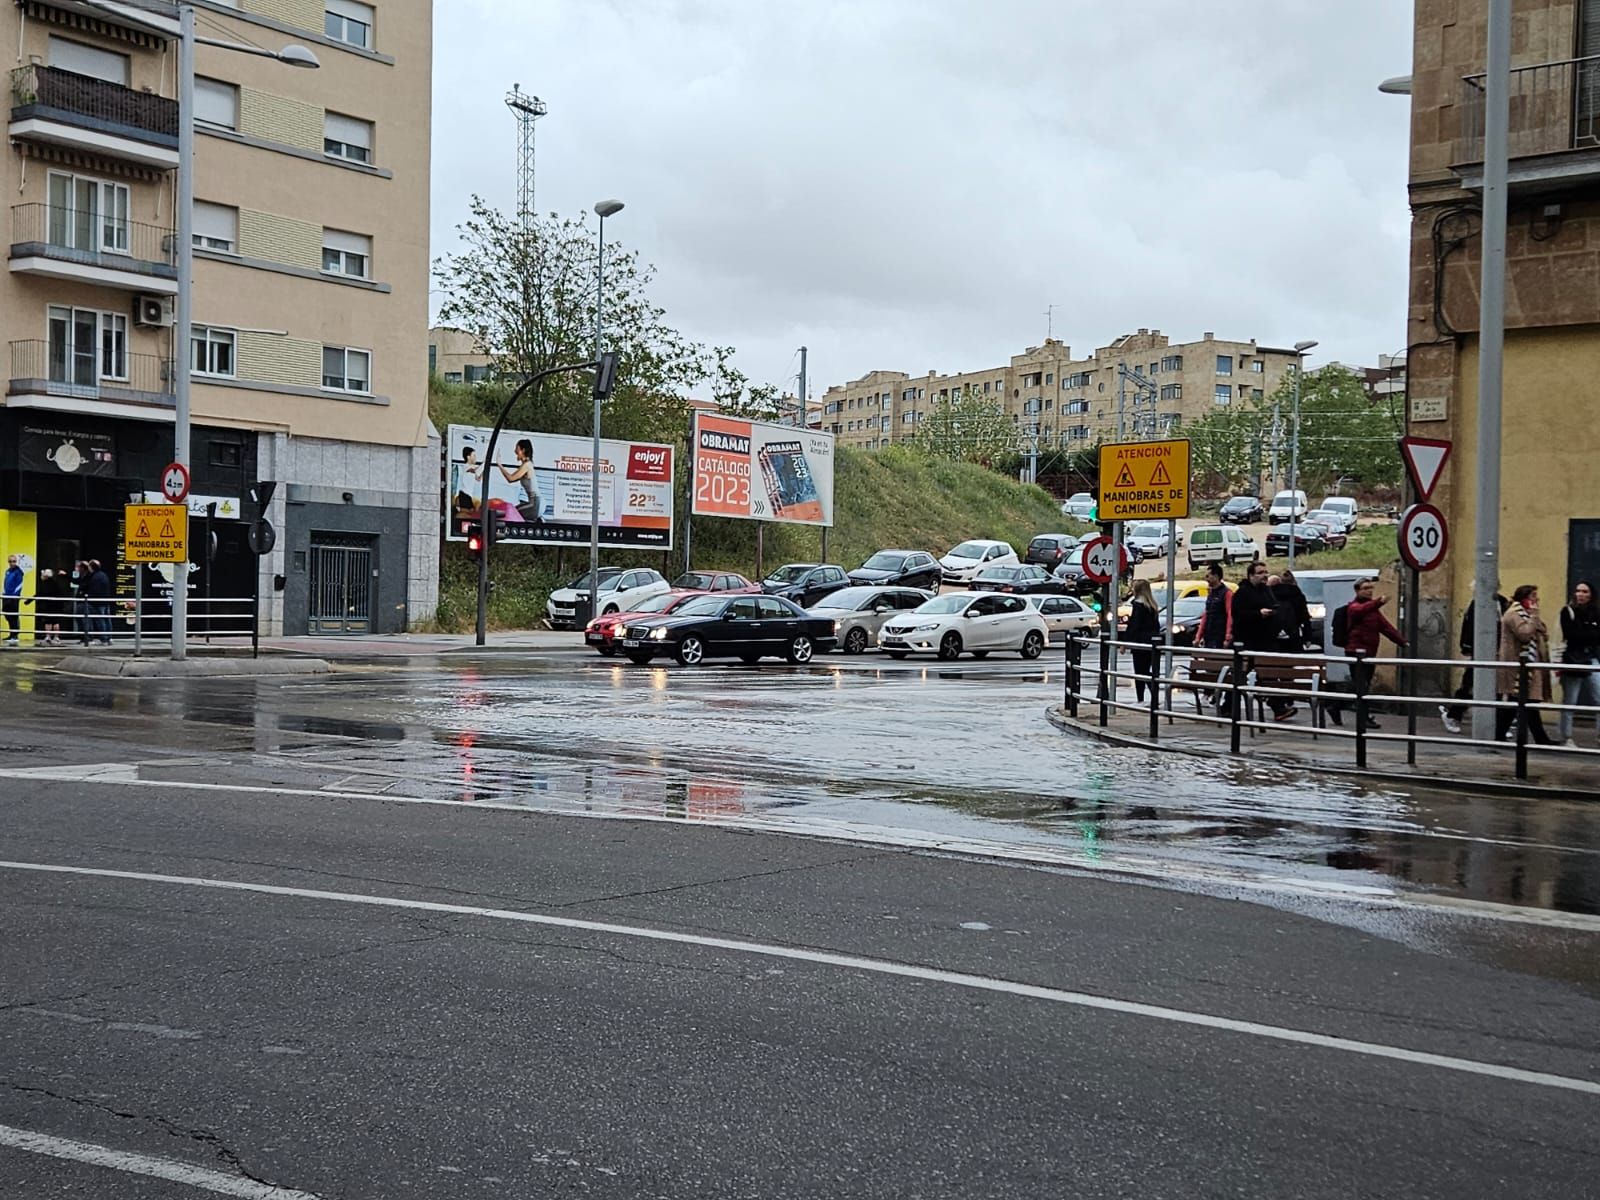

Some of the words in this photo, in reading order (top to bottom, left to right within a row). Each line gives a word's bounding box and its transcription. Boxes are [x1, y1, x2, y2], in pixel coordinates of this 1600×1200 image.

[702, 434, 750, 453] OBRAMAT
[766, 442, 801, 453] OBRAMAT
[634, 449, 665, 465] enjoy!
[792, 458, 806, 469] 20
[554, 460, 577, 472] TODO
[578, 463, 616, 474] INCIDO
[698, 456, 751, 477] CATÁLOGO
[796, 468, 809, 478] 23
[697, 474, 751, 506] 2023
[1103, 489, 1164, 503] MANIOBRAS
[1169, 488, 1184, 500] DE
[629, 493, 647, 507] 22
[1114, 503, 1171, 515] CAMIONES
[1412, 526, 1440, 548] 30
[128, 541, 171, 549] MANIOBRAS
[174, 541, 184, 549] DE
[135, 550, 175, 559] CAMIONES
